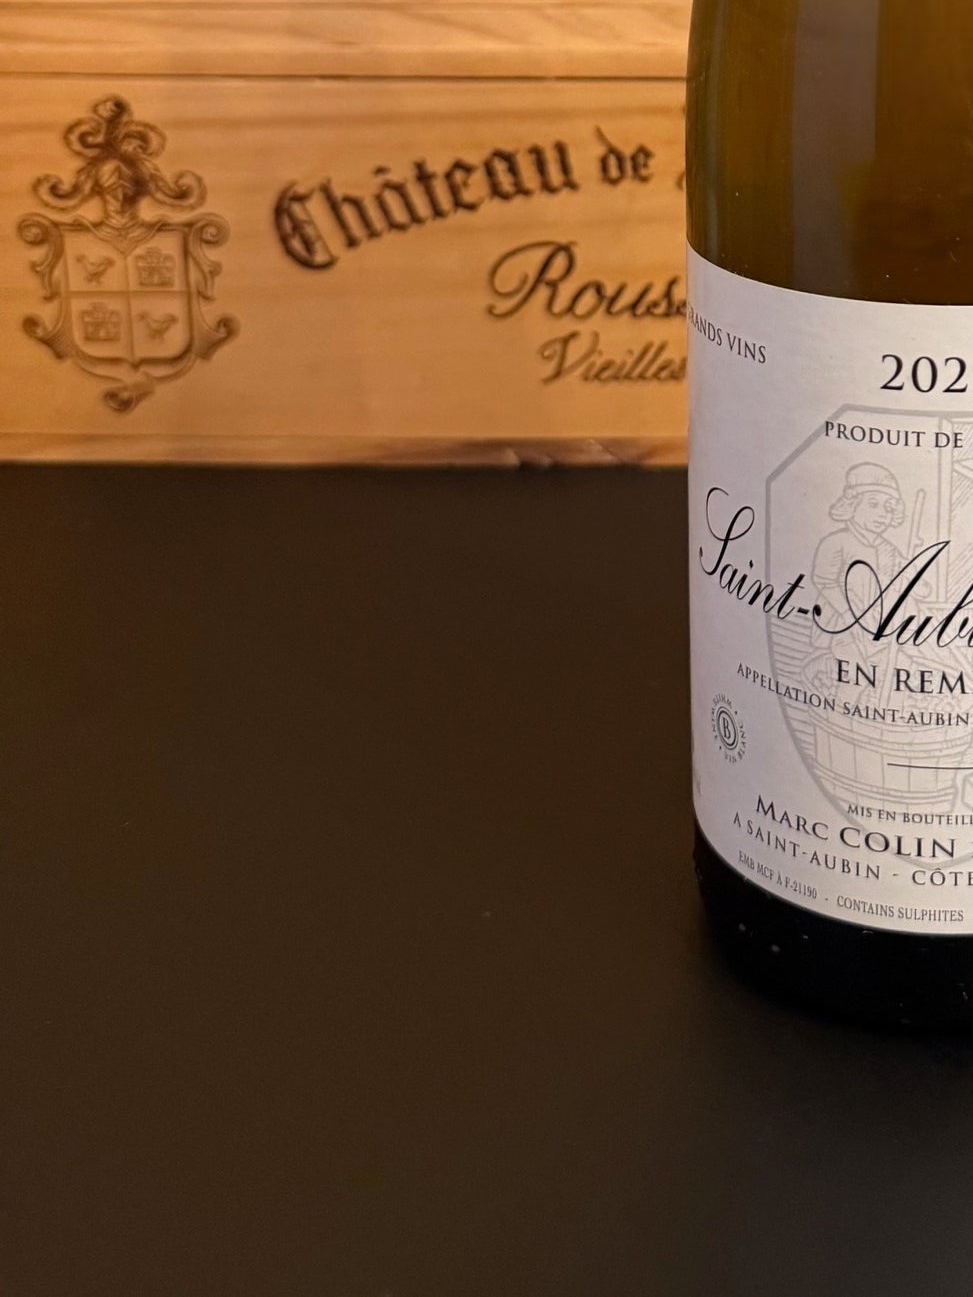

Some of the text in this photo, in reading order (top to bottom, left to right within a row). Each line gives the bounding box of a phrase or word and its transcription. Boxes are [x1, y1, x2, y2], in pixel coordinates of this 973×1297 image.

[274, 126, 654, 271] Château de
[688, 303, 767, 364] RANDS VINS
[825, 421, 926, 448] PRODUIT
[934, 431, 963, 448] DE
[736, 662, 836, 712] APPELLATION
[843, 702, 969, 726] SAINT-AUBIN
[836, 659, 878, 688] EN
[756, 795, 829, 840] MARC
[839, 826, 956, 859] COLIN
[847, 803, 873, 819] MIS
[878, 810, 897, 822] EN
[733, 812, 742, 828] A
[747, 820, 880, 880] SAINT-AUBIN
[738, 850, 755, 870] EMB
[757, 860, 775, 881] MCF
[836, 895, 895, 918] CONTAINS
[898, 906, 964, 922] SULPHITES
